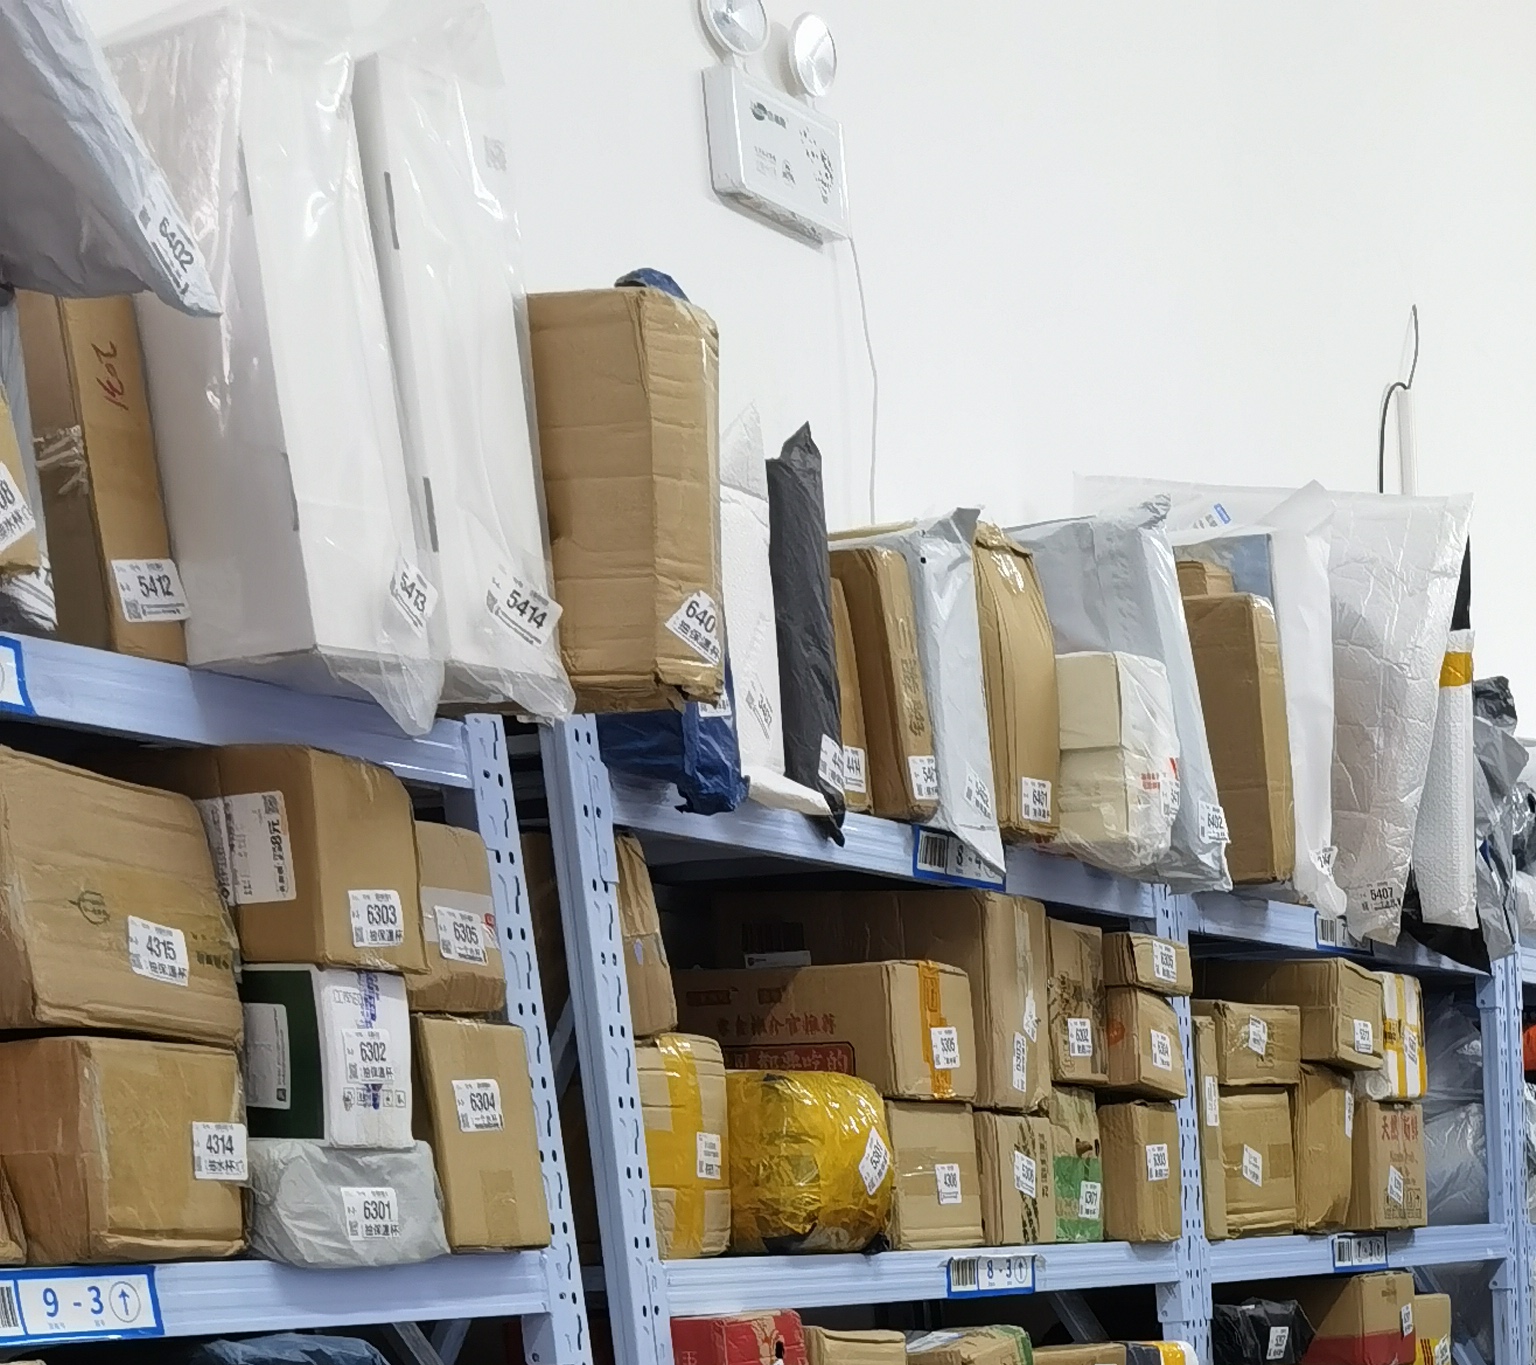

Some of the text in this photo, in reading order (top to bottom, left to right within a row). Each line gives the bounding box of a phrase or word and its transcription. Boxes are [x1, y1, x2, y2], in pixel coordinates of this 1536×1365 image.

[138, 575, 173, 597] 5412
[400, 572, 426, 611] 5413
[507, 590, 547, 628] 5414
[367, 904, 396, 924] 6303
[453, 922, 478, 944] 6305
[146, 936, 176, 960] 4315
[360, 1042, 386, 1062] 6302
[470, 1092, 495, 1111] 6304
[206, 1134, 234, 1154] 4314
[363, 1200, 392, 1220] 6301
